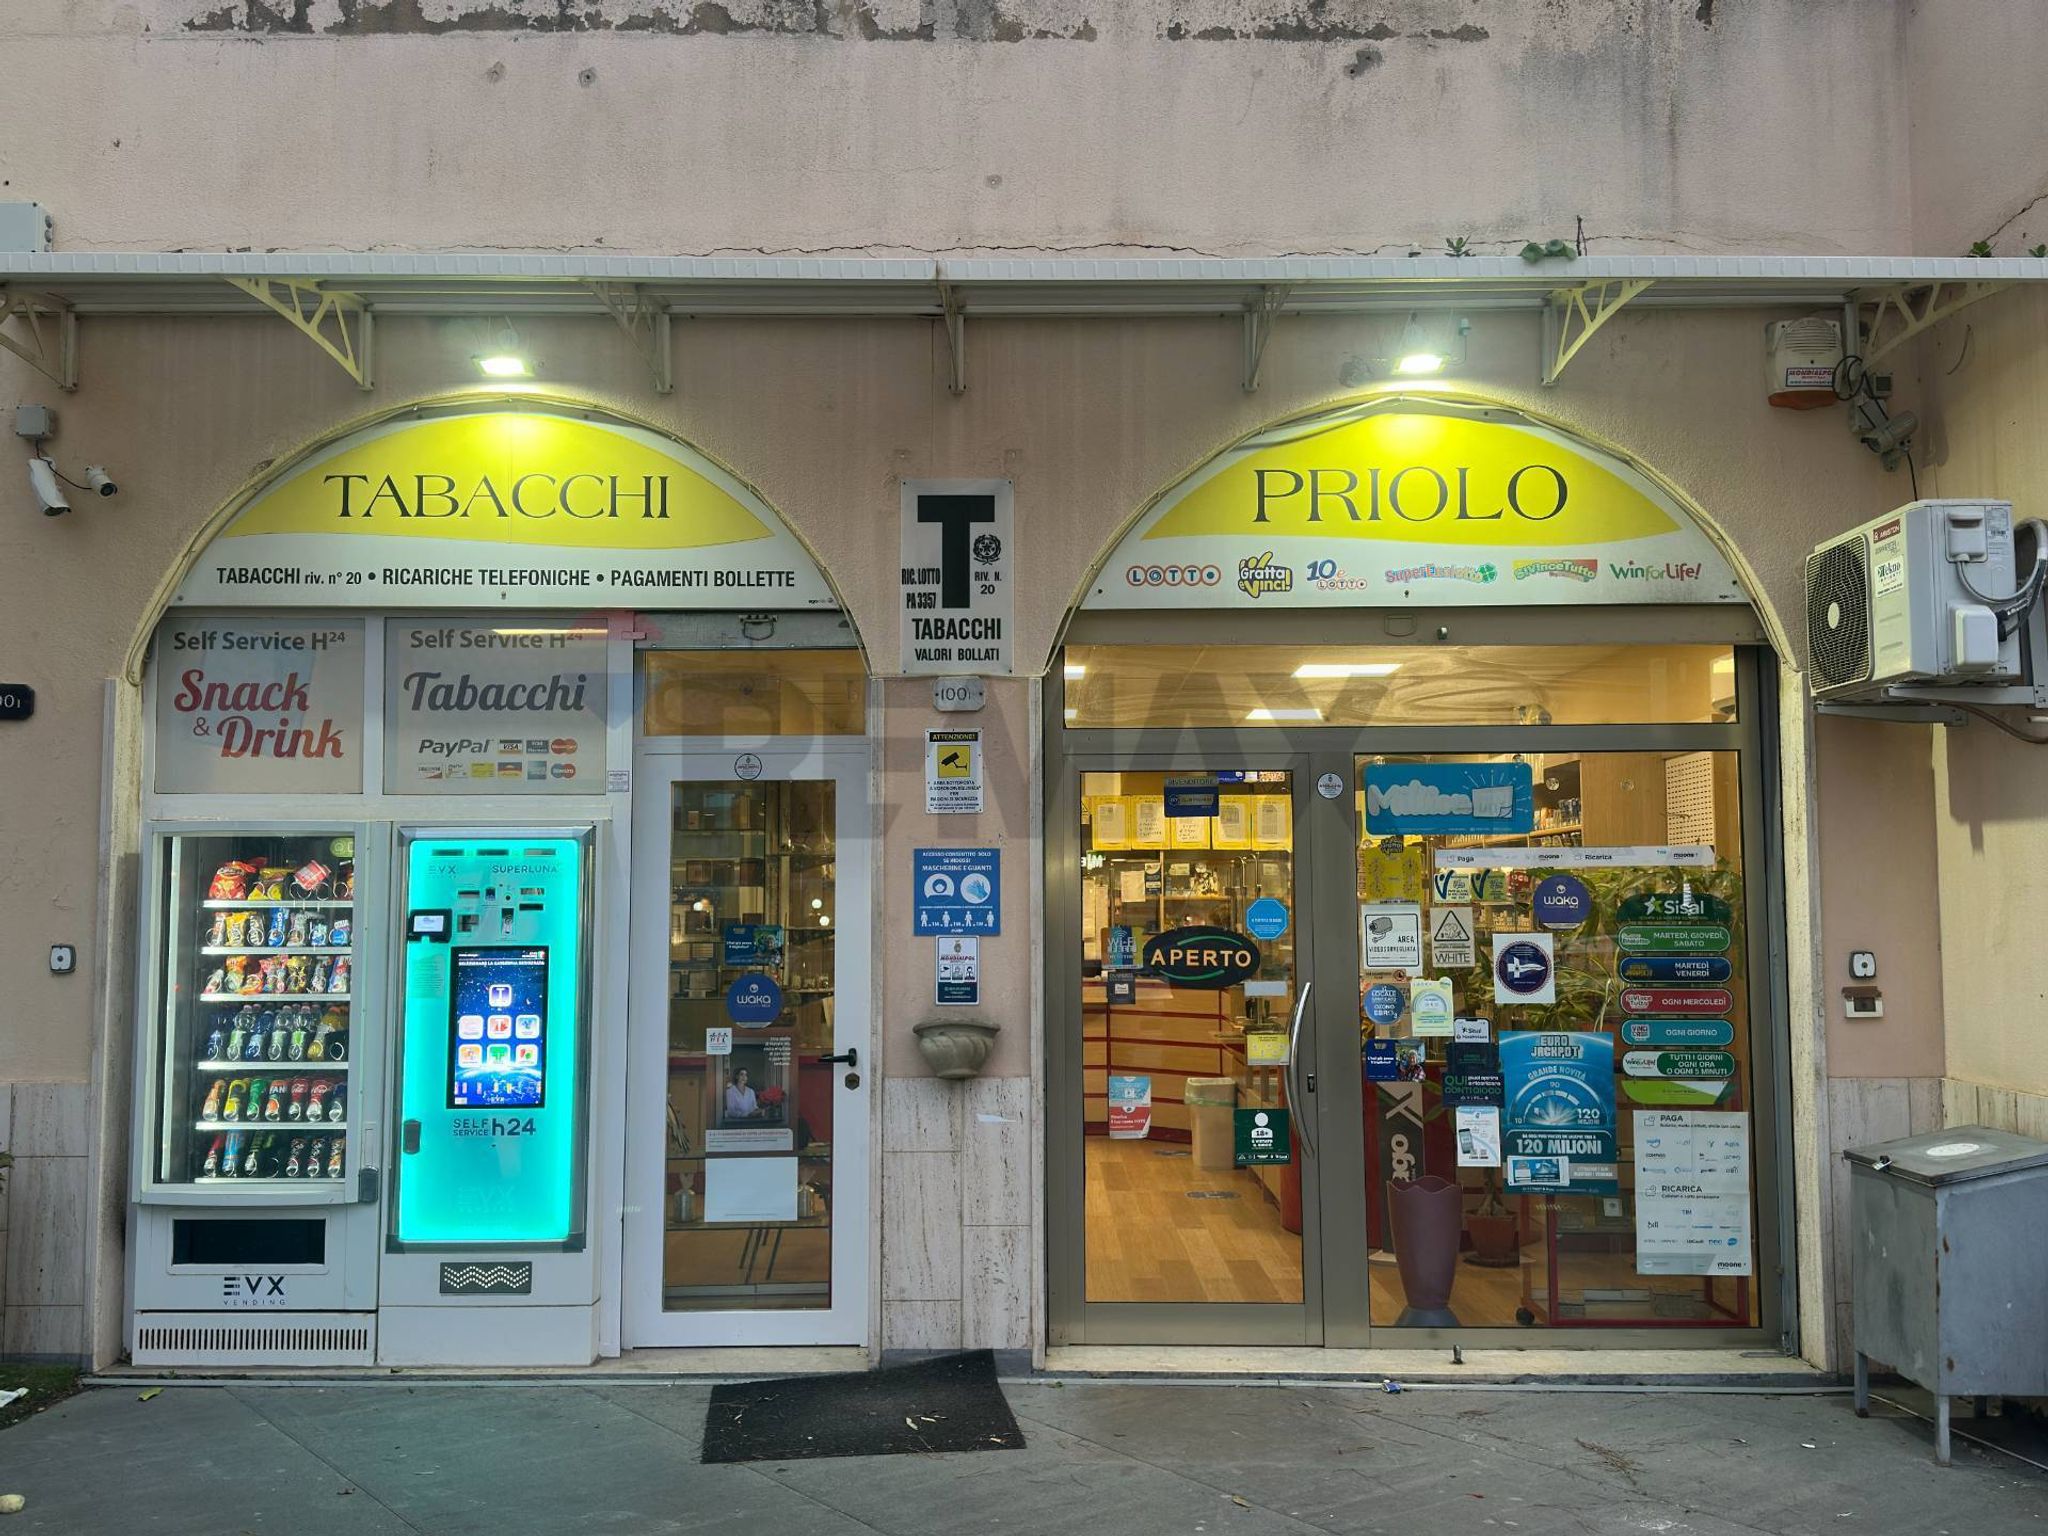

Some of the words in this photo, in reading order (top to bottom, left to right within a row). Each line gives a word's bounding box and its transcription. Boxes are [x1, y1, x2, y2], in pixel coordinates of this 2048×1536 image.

[323, 473, 670, 519] TABACCHI
[1252, 465, 1568, 522] PRIOLO
[918, 495, 995, 608] T
[216, 567, 301, 584] TABACCHI
[304, 569, 324, 585] riv.
[328, 571, 342, 585] n°
[346, 571, 362, 585] 20
[382, 569, 473, 585] RICARICHE
[478, 569, 590, 586] TELEFONICHE
[610, 570, 708, 587] PAGAMENTI
[713, 570, 795, 587] BOLLETTE
[902, 568, 917, 585] RIC.
[917, 568, 941, 585] LOTTO
[975, 571, 990, 582] RIV.
[994, 571, 1002, 582] N.
[1126, 565, 1221, 587] LOTTO
[1240, 566, 1286, 580] Gratta
[1306, 559, 1337, 582] 10
[980, 584, 995, 595] 20
[911, 618, 1002, 640] TABACCHI
[173, 631, 218, 651] Self
[222, 631, 305, 650] Service
[410, 629, 454, 649] Self
[459, 630, 544, 649] Service
[915, 648, 952, 661] VALORI
[957, 648, 1000, 661] BOLLATI
[174, 668, 310, 712] Snack
[403, 671, 587, 711] Tabacchi
[193, 716, 210, 736] &
[216, 715, 344, 759] Drink
[418, 739, 492, 757] PayPal
[491, 864, 558, 874] SUPERLUNA
[1543, 896, 1579, 908] waka
[1664, 900, 1705, 915] Sisal
[1397, 936, 1415, 944] AREA
[1150, 948, 1252, 968] APERTO
[1434, 953, 1471, 964] WHITE
[1674, 961, 1709, 969] MARTEDÌ
[1675, 969, 1710, 977] VENERDÌ
[736, 995, 771, 1004] waka
[1683, 997, 1726, 1005] MERCOLEDÌ
[1539, 1035, 1570, 1046] EURO
[1531, 1046, 1582, 1058] JACKPOT
[1527, 1066, 1558, 1081] GRANDE
[1577, 1108, 1600, 1119] 120
[1660, 1114, 1683, 1122] PAGA
[453, 1118, 488, 1129] SELF
[492, 1117, 536, 1136] h24
[1516, 1140, 1543, 1154] 120
[1547, 1140, 1602, 1154] MILIONI
[223, 1275, 285, 1296] EVX
